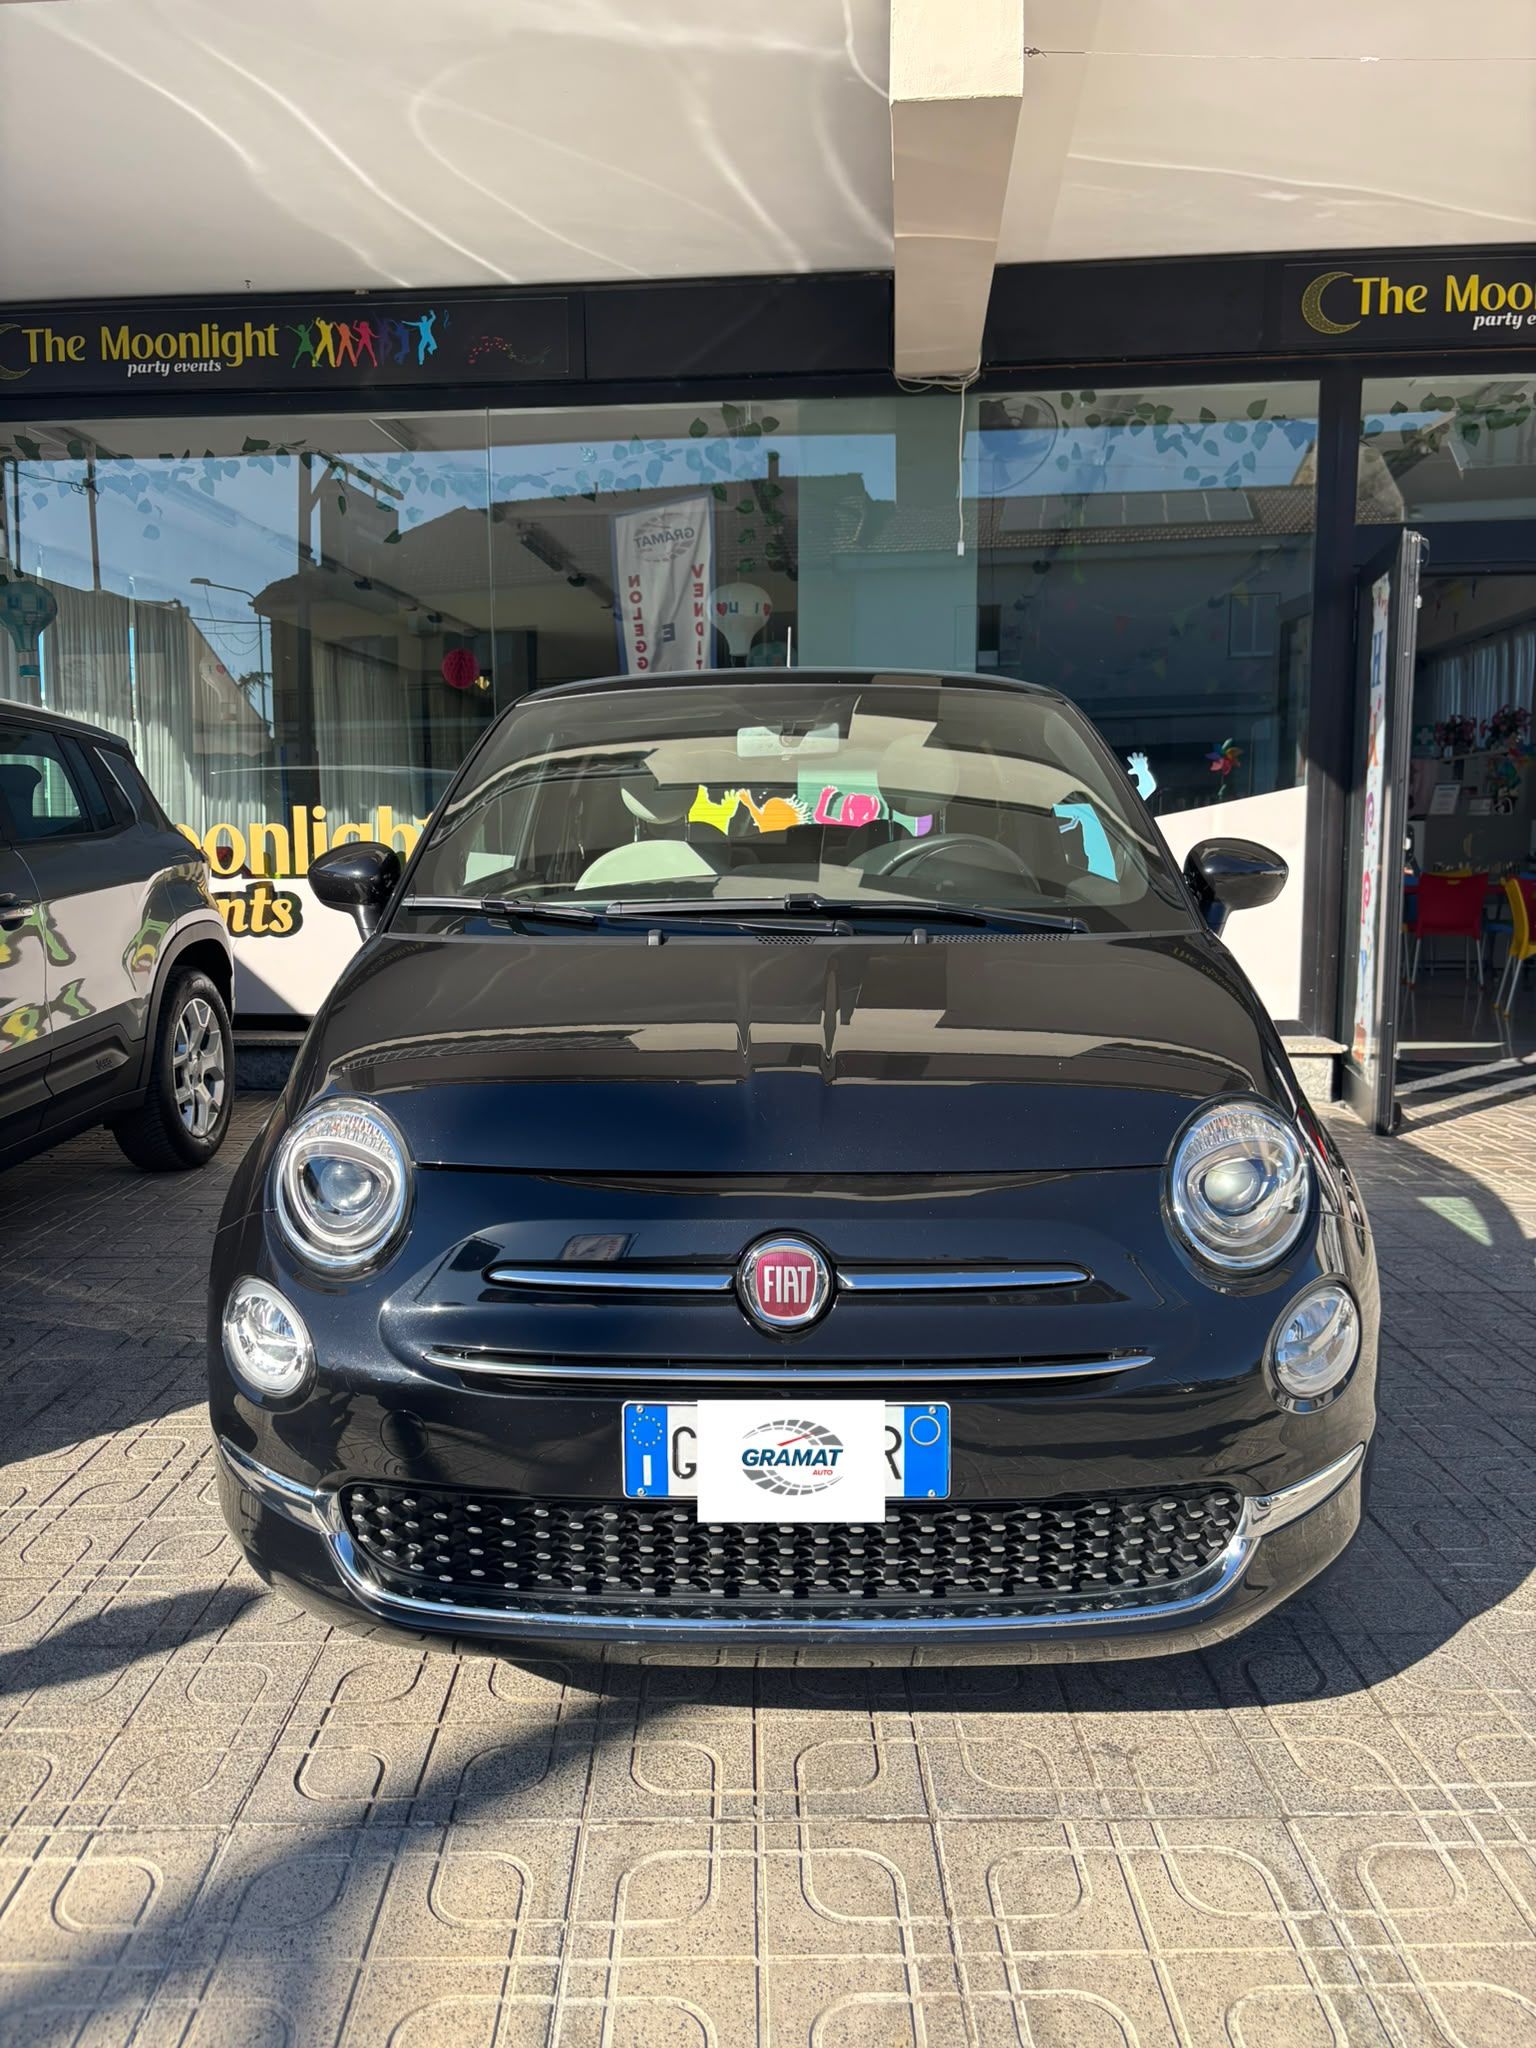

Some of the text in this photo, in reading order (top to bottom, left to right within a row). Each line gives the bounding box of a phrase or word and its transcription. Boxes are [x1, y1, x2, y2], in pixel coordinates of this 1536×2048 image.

[1352, 274, 1536, 316] The Moo
[1473, 312, 1524, 331] party
[21, 322, 280, 368] The Moonlight
[127, 358, 223, 378] party events
[763, 1265, 812, 1304] FIAT
